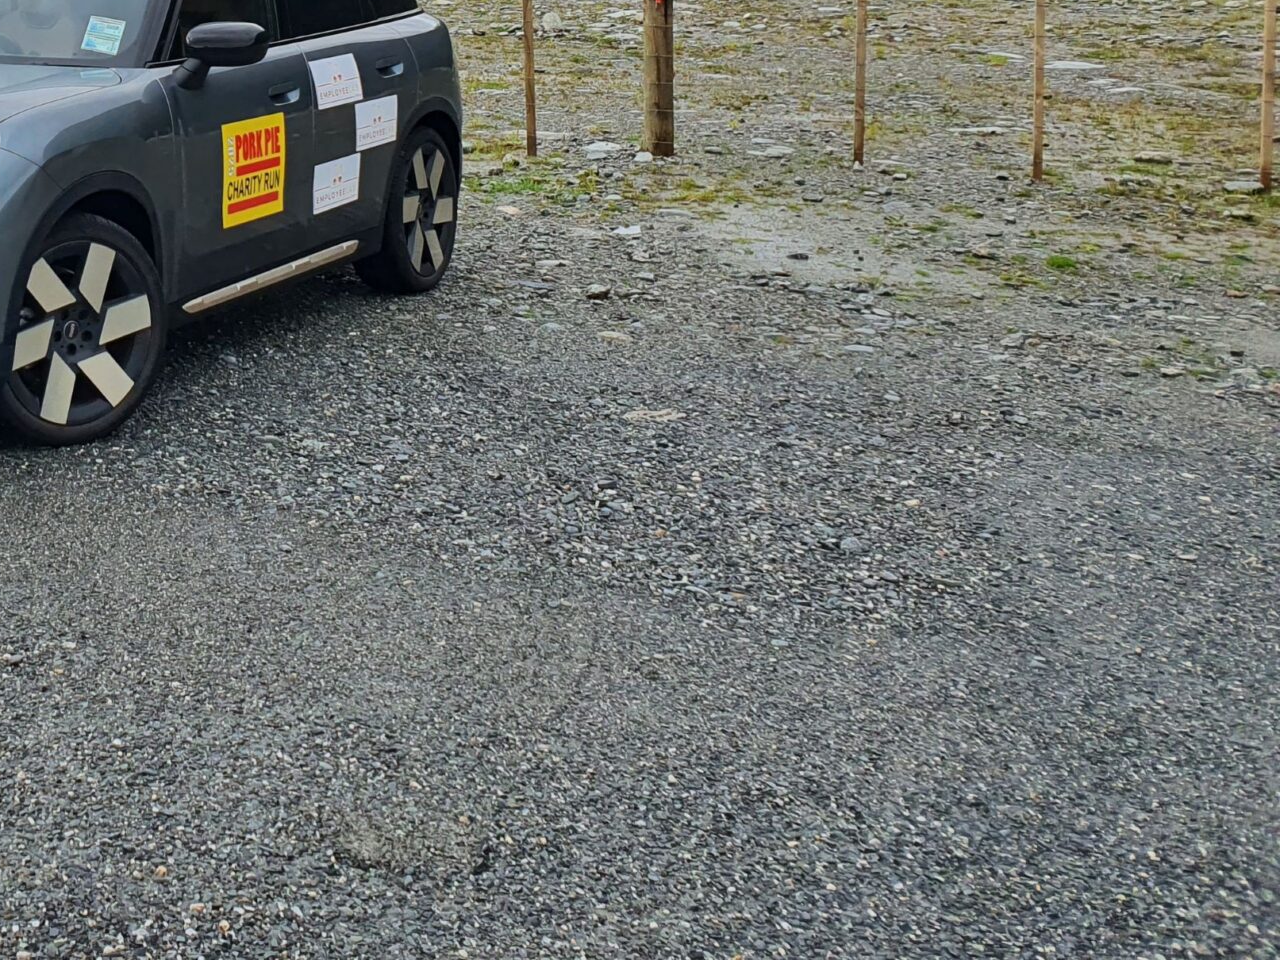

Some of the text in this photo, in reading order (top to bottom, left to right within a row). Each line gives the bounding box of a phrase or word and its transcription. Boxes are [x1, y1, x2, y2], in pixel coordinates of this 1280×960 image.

[235, 126, 280, 163] PORK PIE
[227, 170, 280, 201] CHARITY RUN
